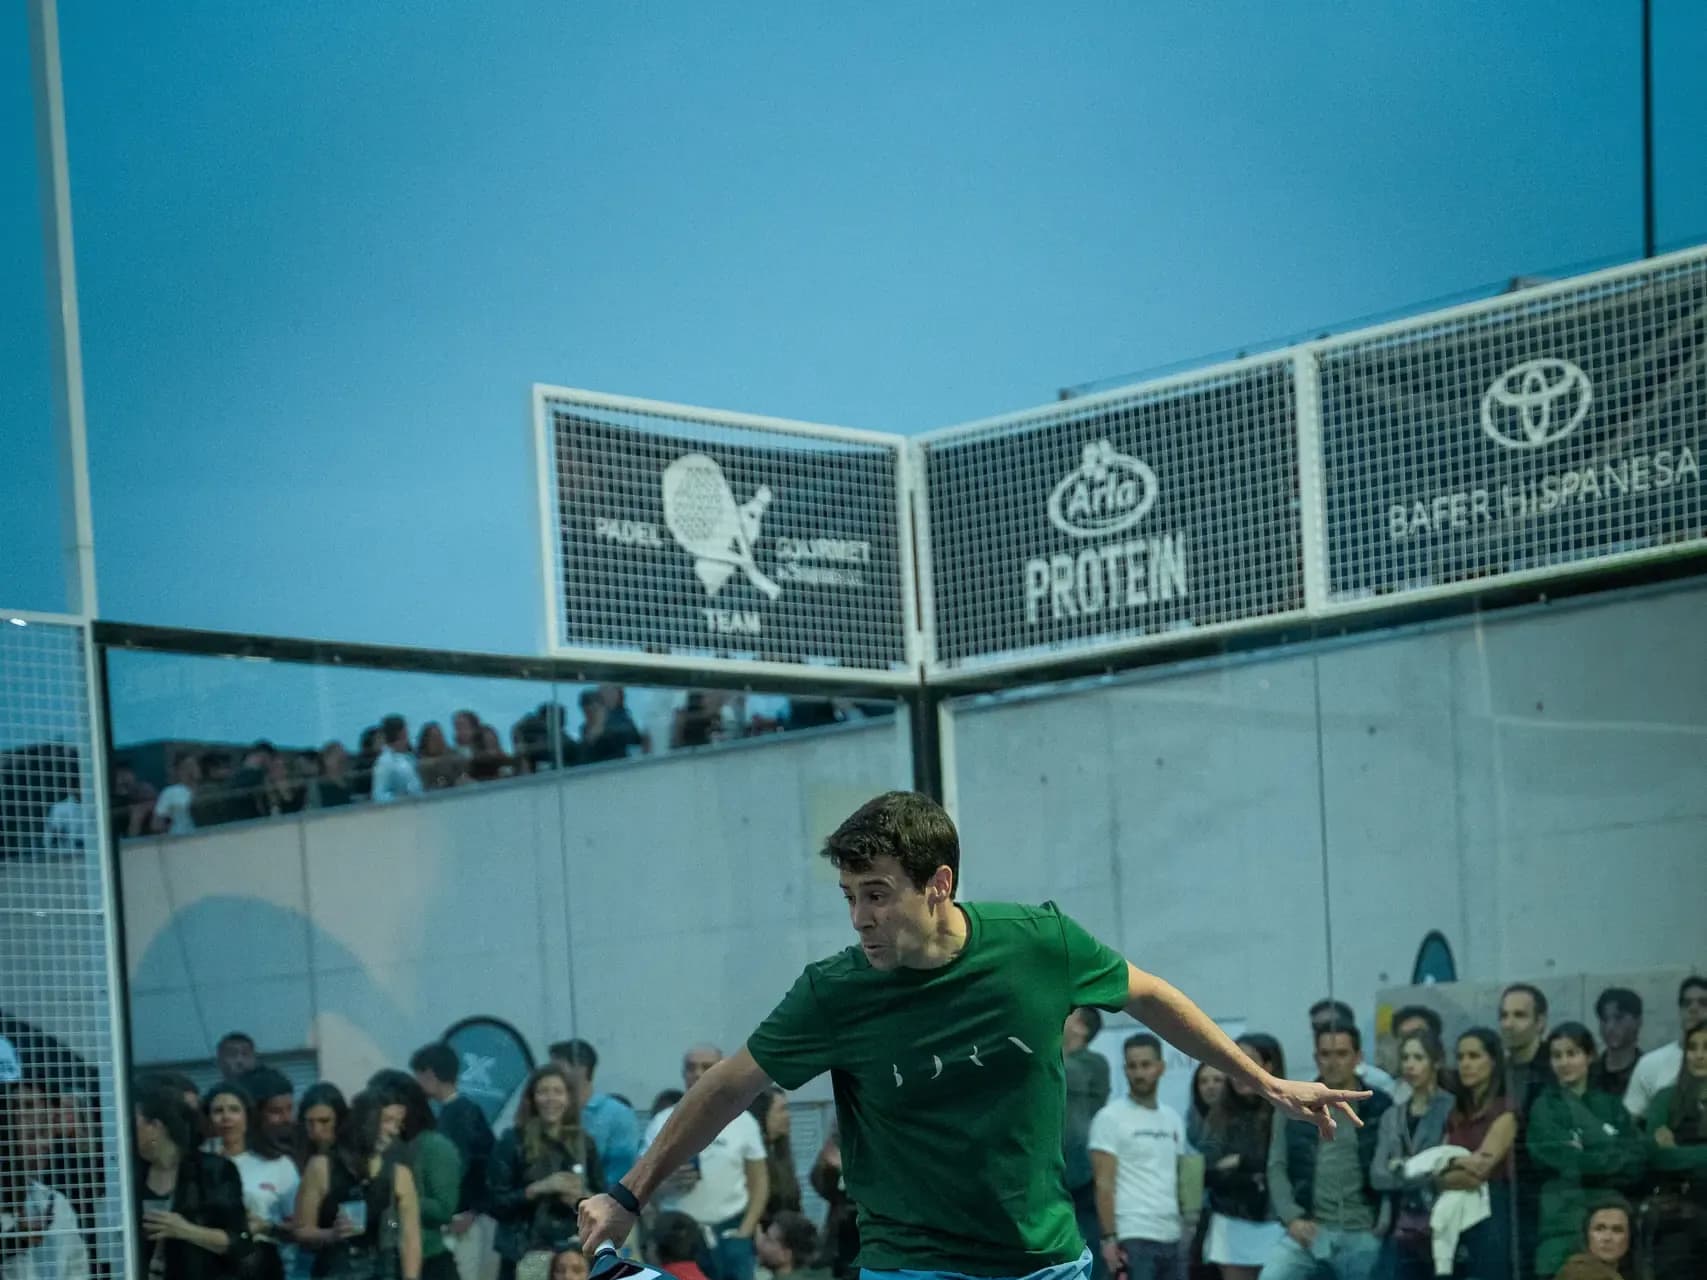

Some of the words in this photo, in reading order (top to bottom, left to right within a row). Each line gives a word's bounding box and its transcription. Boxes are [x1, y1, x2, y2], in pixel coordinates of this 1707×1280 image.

[1067, 472, 1137, 519] Arla
[1389, 488, 1493, 539] BAFER
[1502, 447, 1700, 519] HISPANESA
[595, 517, 663, 547] PADEL
[1026, 531, 1188, 625] PROTEIN
[703, 608, 761, 635] TEAM
